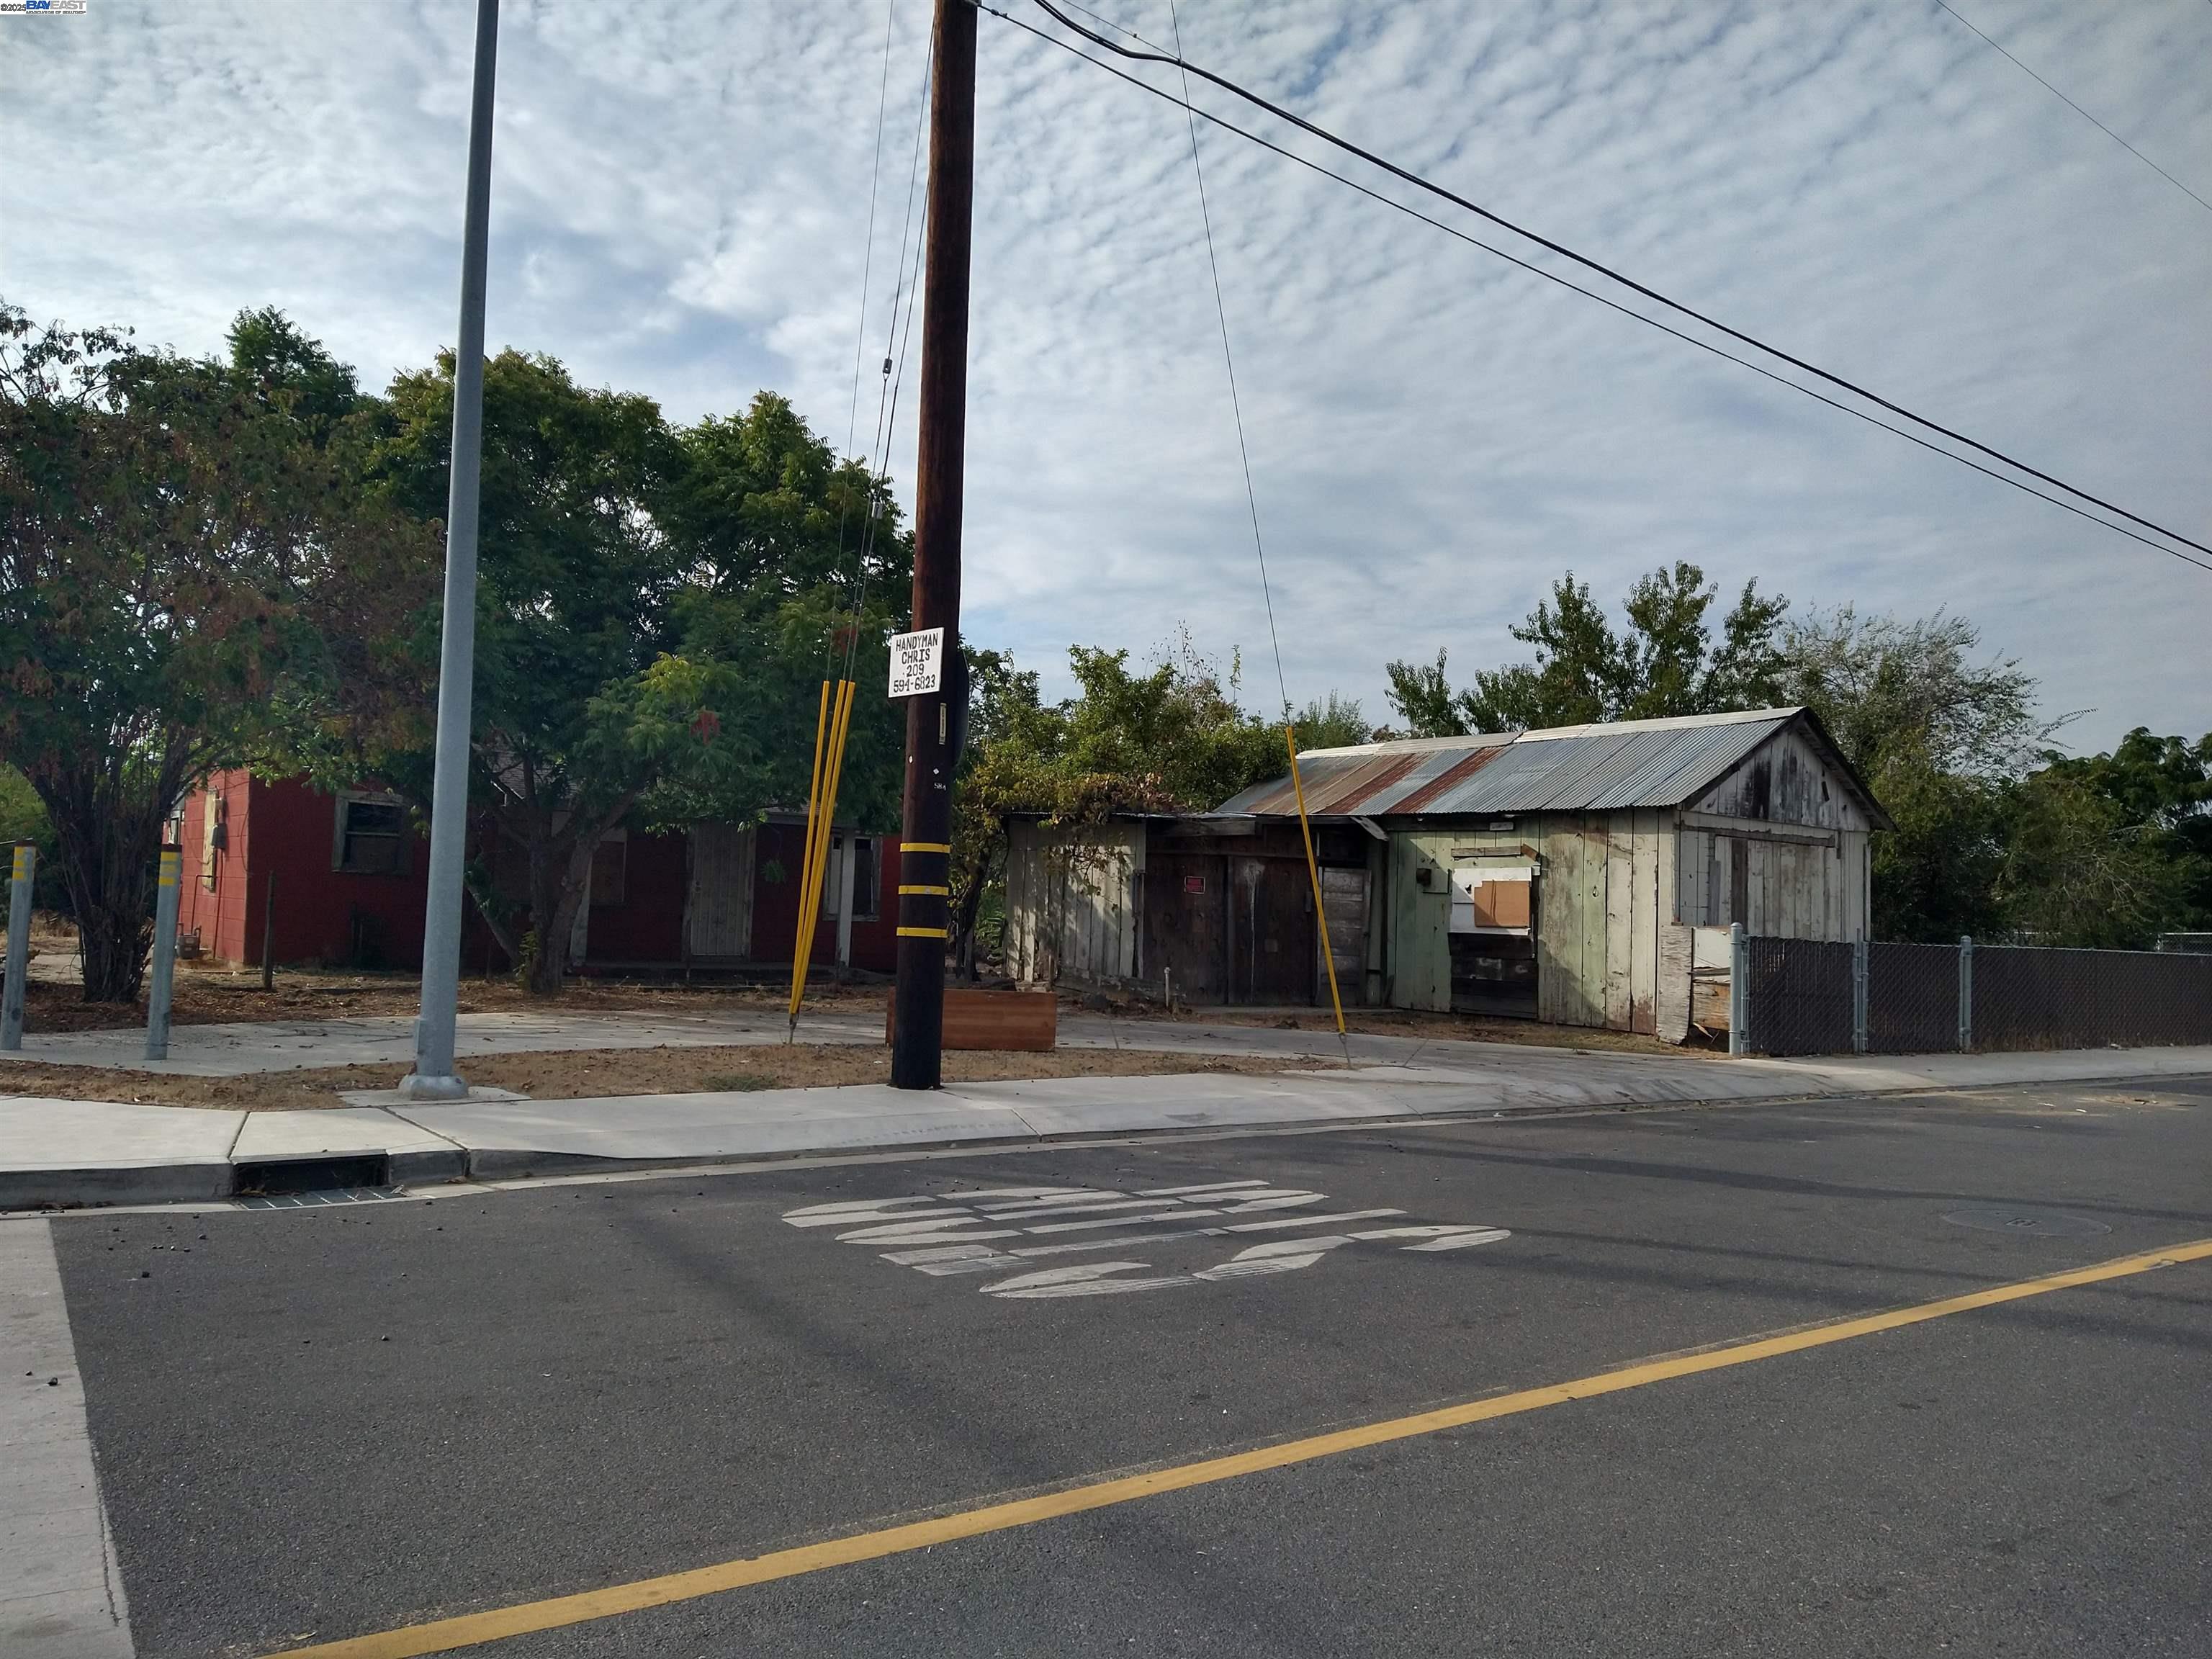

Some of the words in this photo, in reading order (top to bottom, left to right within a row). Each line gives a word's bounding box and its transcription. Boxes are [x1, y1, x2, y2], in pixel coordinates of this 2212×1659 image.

[896, 632, 938, 652] HANDYMAN
[902, 648, 930, 665] CHRIS
[907, 663, 925, 678] 209
[893, 674, 935, 693] 594-6823
